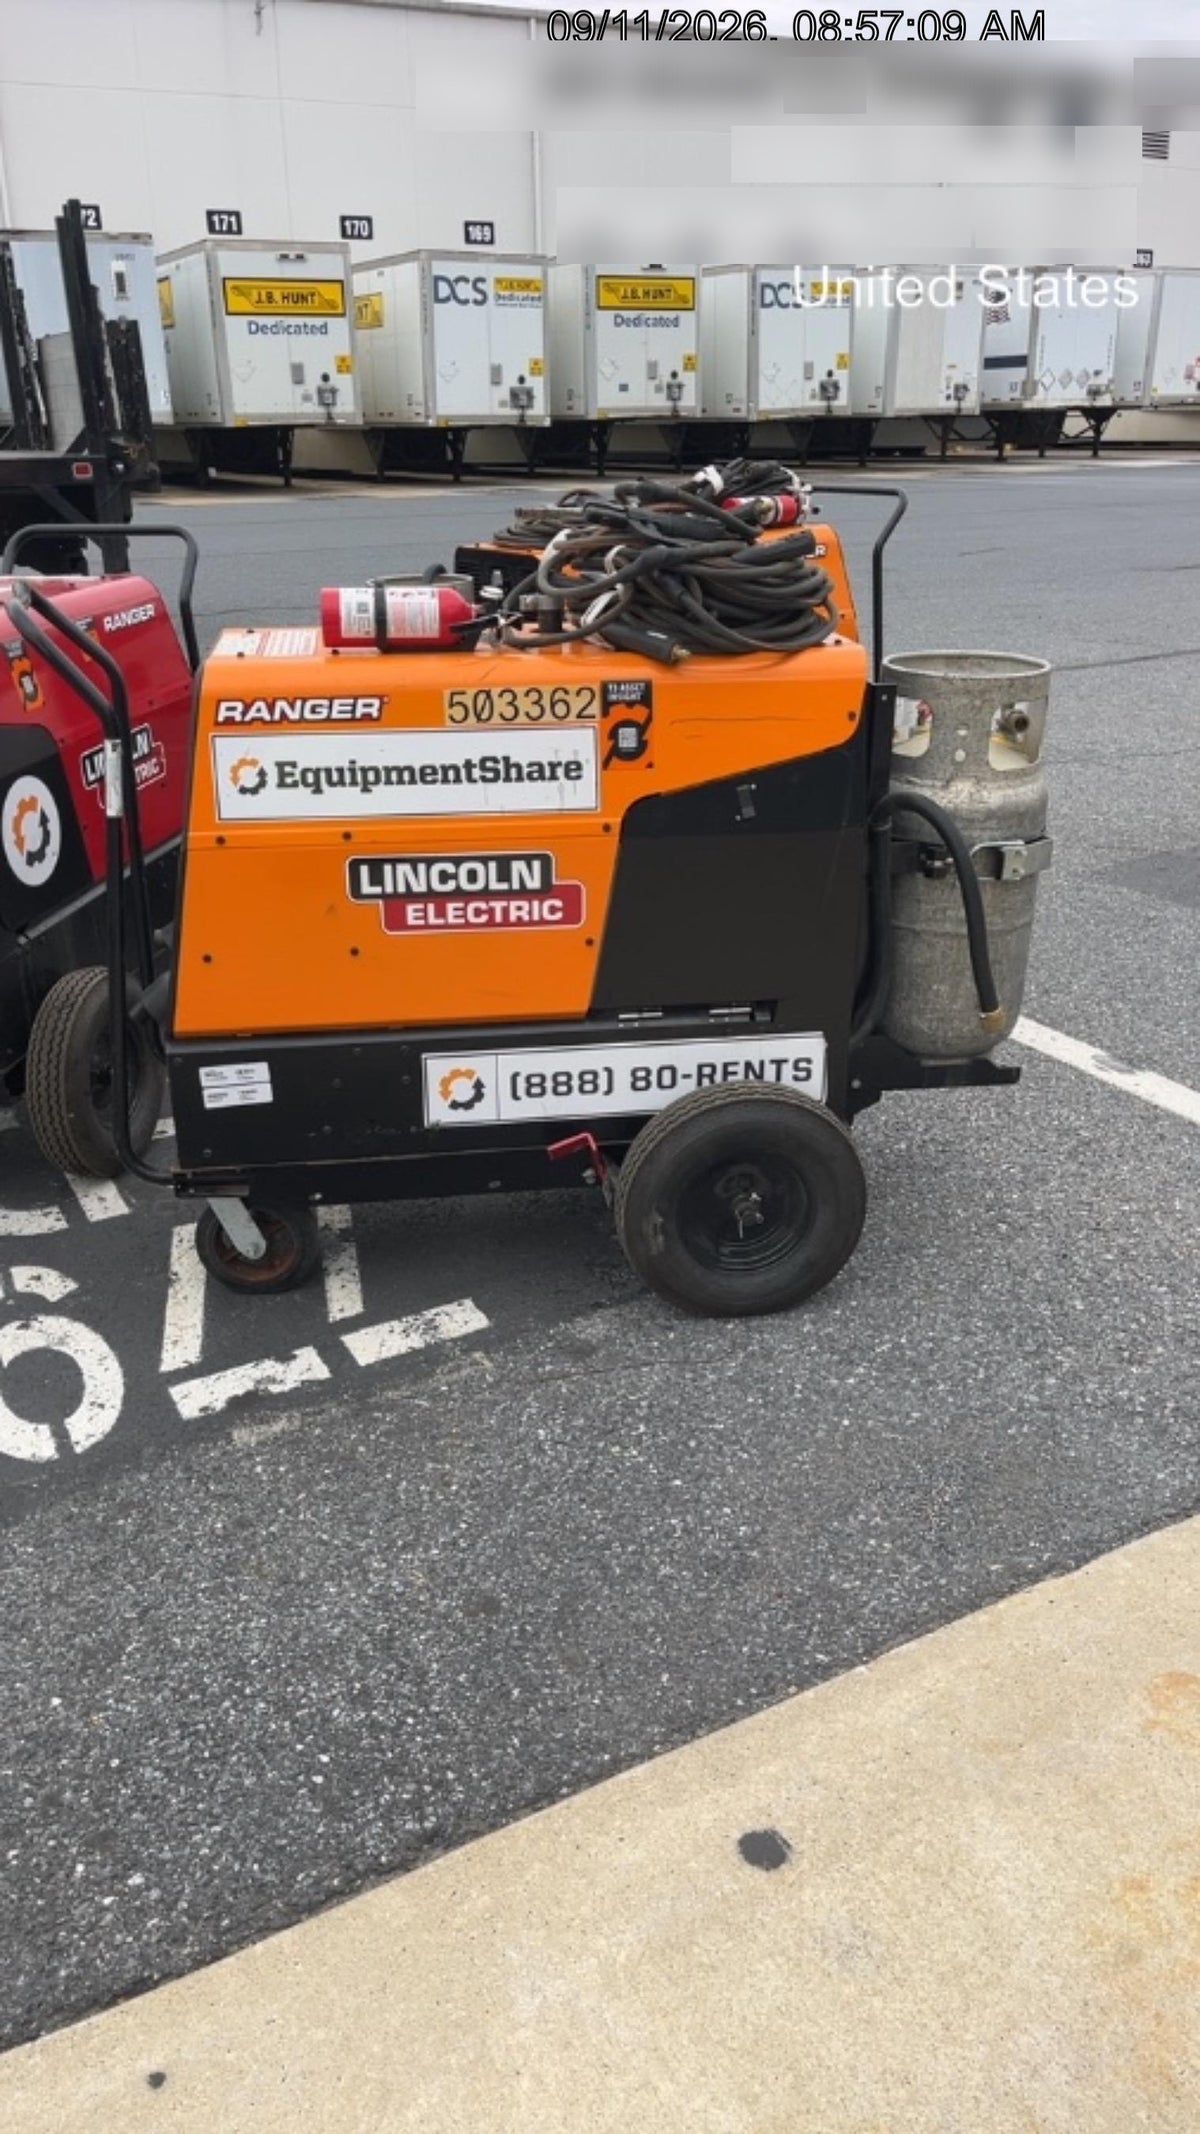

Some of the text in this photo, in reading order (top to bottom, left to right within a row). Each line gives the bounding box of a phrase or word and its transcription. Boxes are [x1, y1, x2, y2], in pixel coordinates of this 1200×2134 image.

[211, 213, 238, 232] 171
[343, 219, 370, 237] 170
[281, 291, 316, 304] HUNT
[433, 275, 487, 306] DCS
[642, 287, 673, 300] HUNT
[248, 320, 328, 335] Dedicated
[614, 313, 679, 328] Dedicated
[103, 603, 155, 633] RANGER
[216, 697, 382, 723] RANGER
[447, 686, 598, 724] 503362
[274, 755, 584, 795] EquipmentShare
[359, 859, 542, 895] LINCOLN
[405, 899, 564, 925] ELECTRIC
[510, 1056, 813, 1101] (888) 80-RENTS
